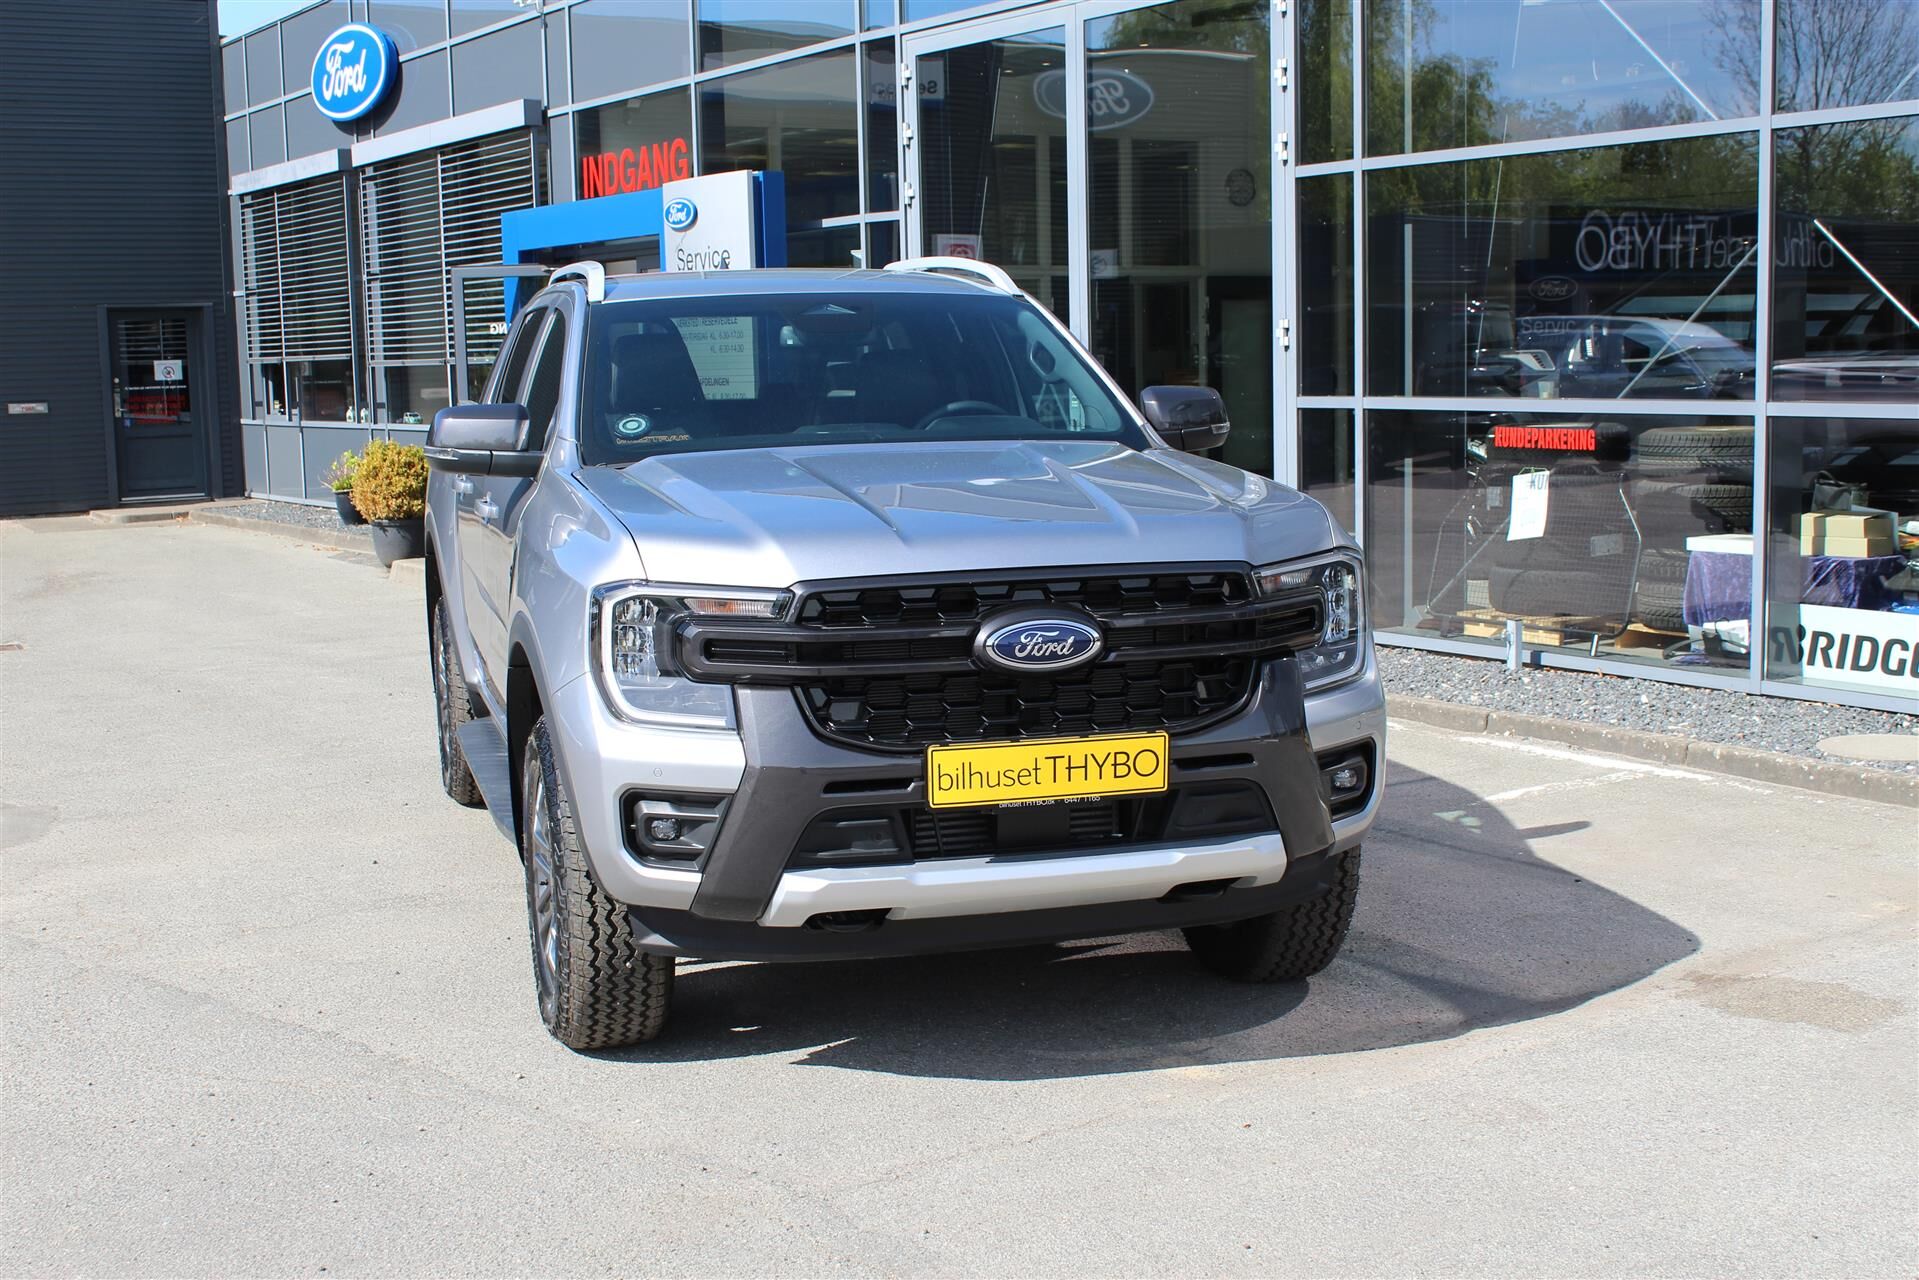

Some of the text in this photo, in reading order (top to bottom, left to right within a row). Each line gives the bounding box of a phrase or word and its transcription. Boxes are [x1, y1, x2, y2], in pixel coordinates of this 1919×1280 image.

[322, 40, 367, 101] Ford
[582, 137, 689, 199] INDGANG
[668, 203, 687, 223] Ford
[676, 245, 731, 271] Service
[1494, 425, 1597, 452] KUNDEPARKERING
[1015, 630, 1074, 659] Ford
